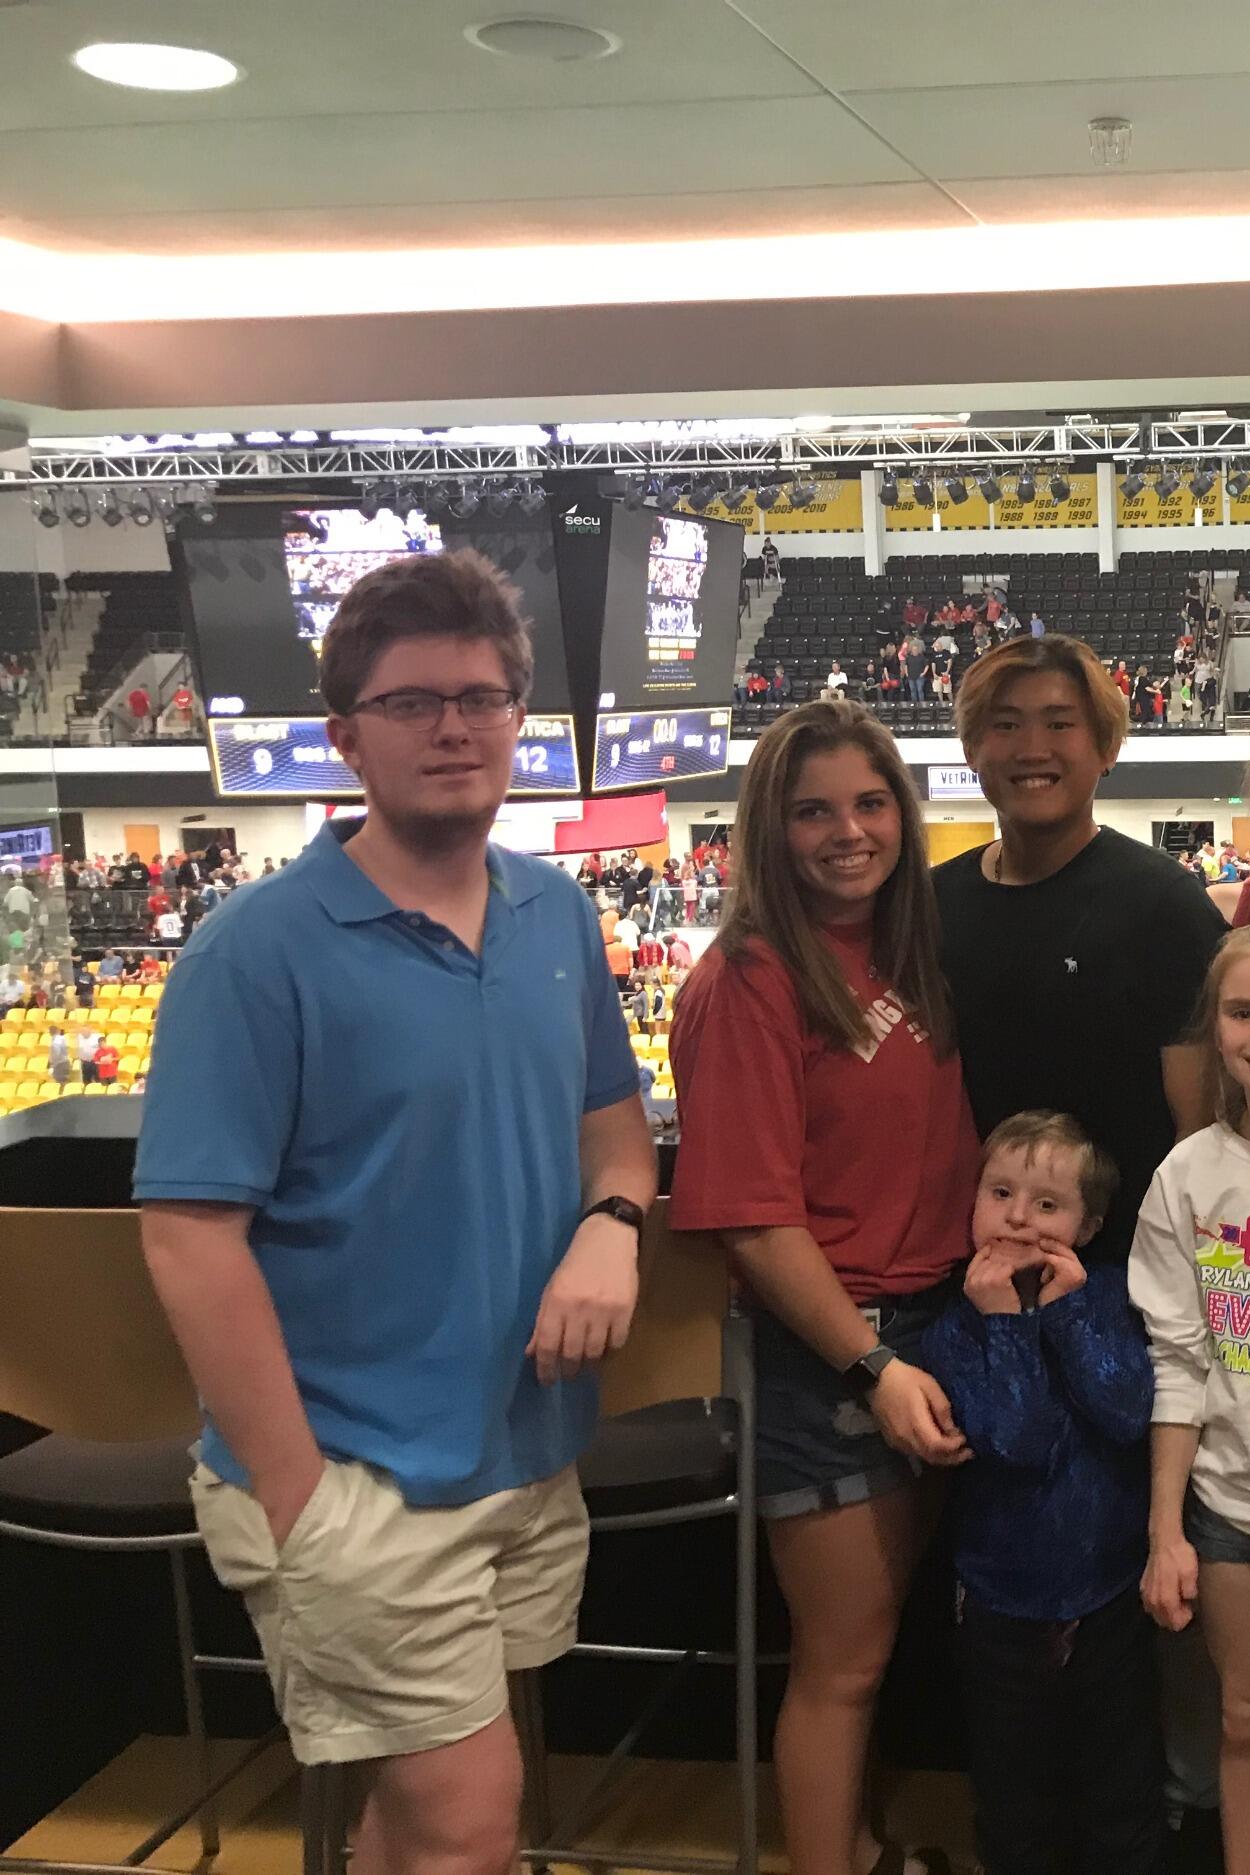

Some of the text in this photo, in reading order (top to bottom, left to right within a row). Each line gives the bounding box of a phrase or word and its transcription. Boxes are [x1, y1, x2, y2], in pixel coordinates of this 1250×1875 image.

[1191, 495, 1216, 505] 193
[1123, 510, 1147, 520] 1994
[1158, 509, 1182, 519] 1995
[565, 516, 600, 526] secu
[253, 748, 273, 775] 9
[515, 745, 548, 773] 12
